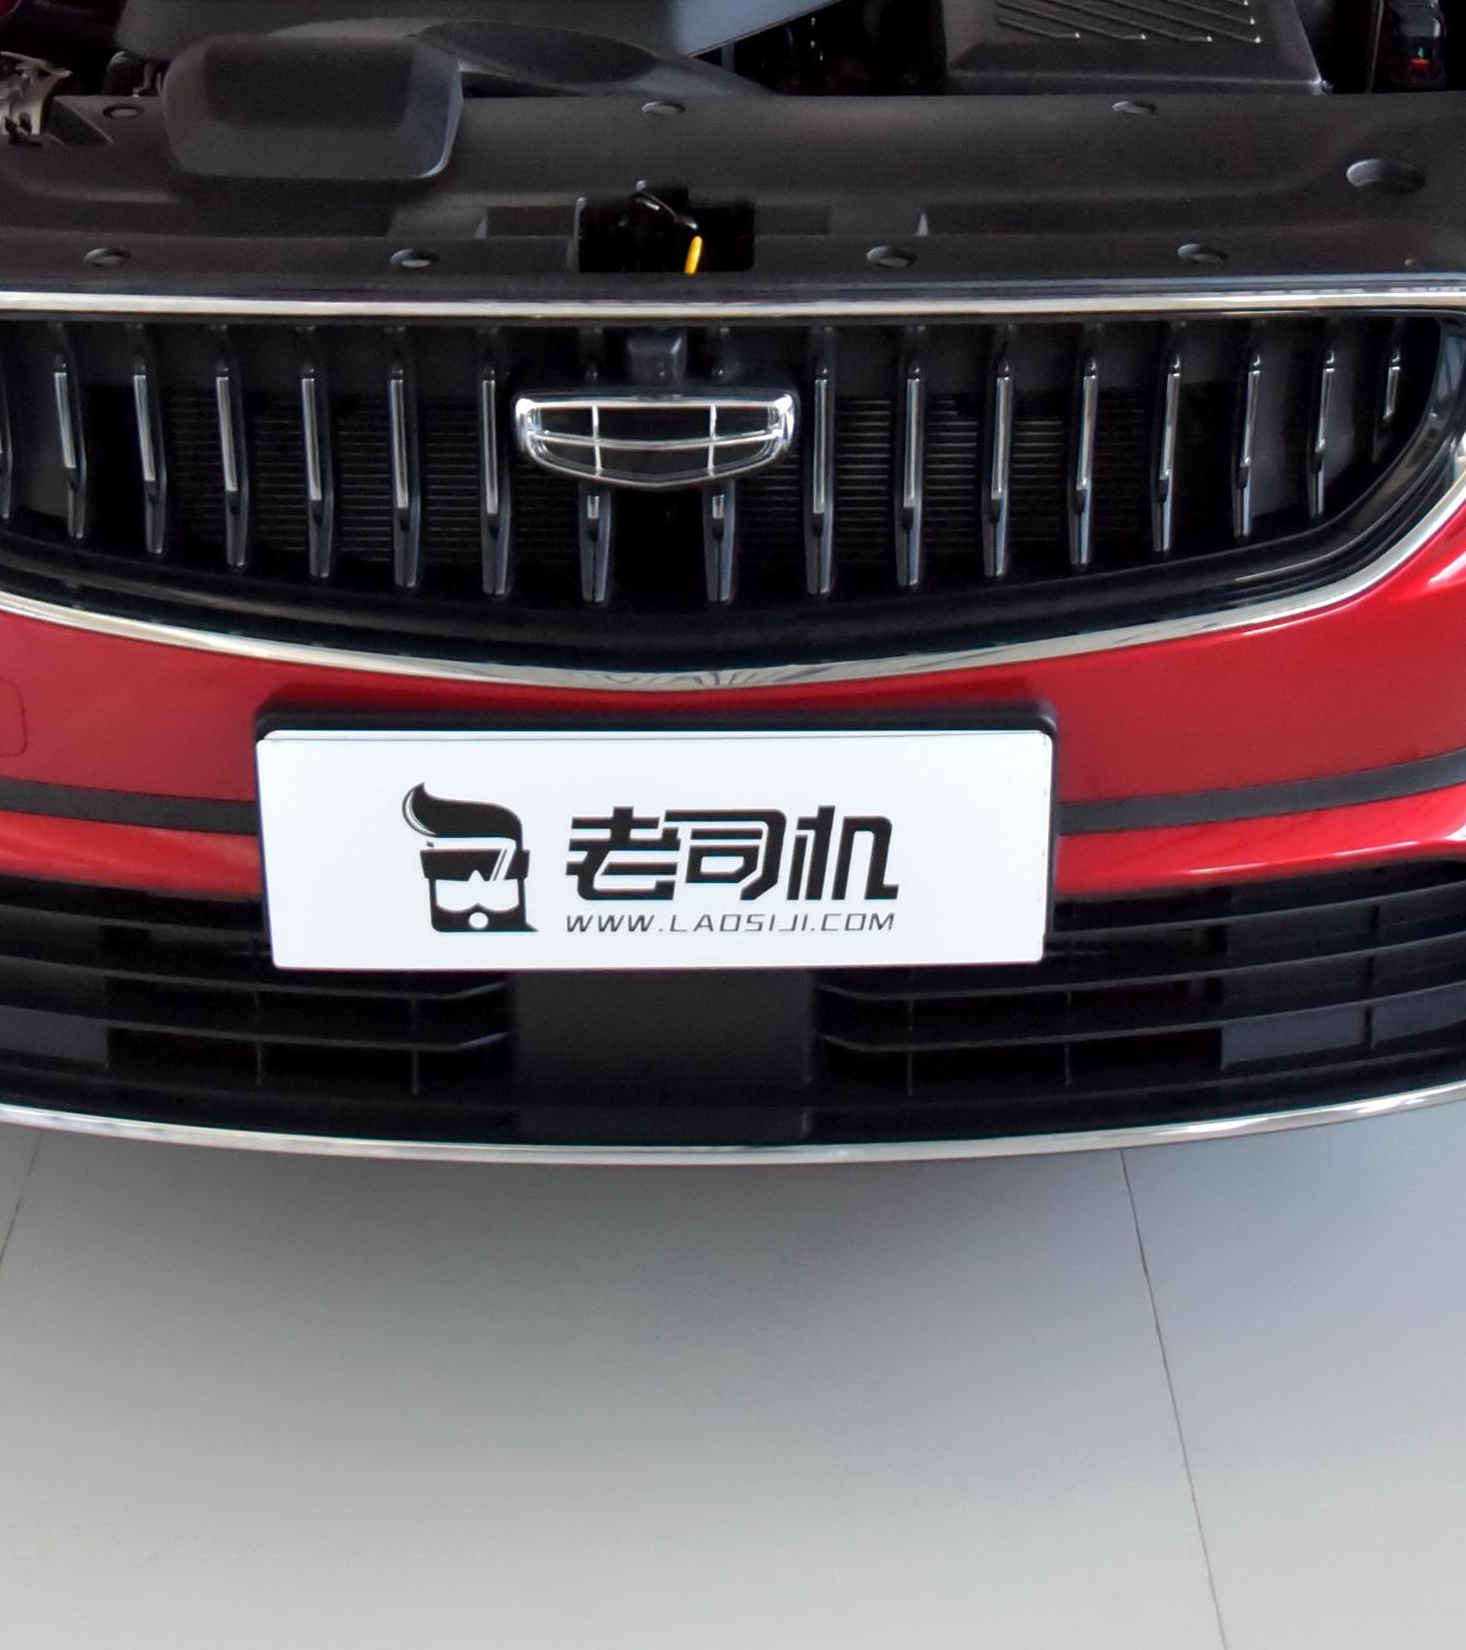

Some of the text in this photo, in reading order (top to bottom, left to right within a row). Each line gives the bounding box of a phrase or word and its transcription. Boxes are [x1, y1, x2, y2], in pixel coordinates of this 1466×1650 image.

[564, 805, 900, 901] 老司机
[564, 913, 896, 934] WWW.LAOSIJI.COM
